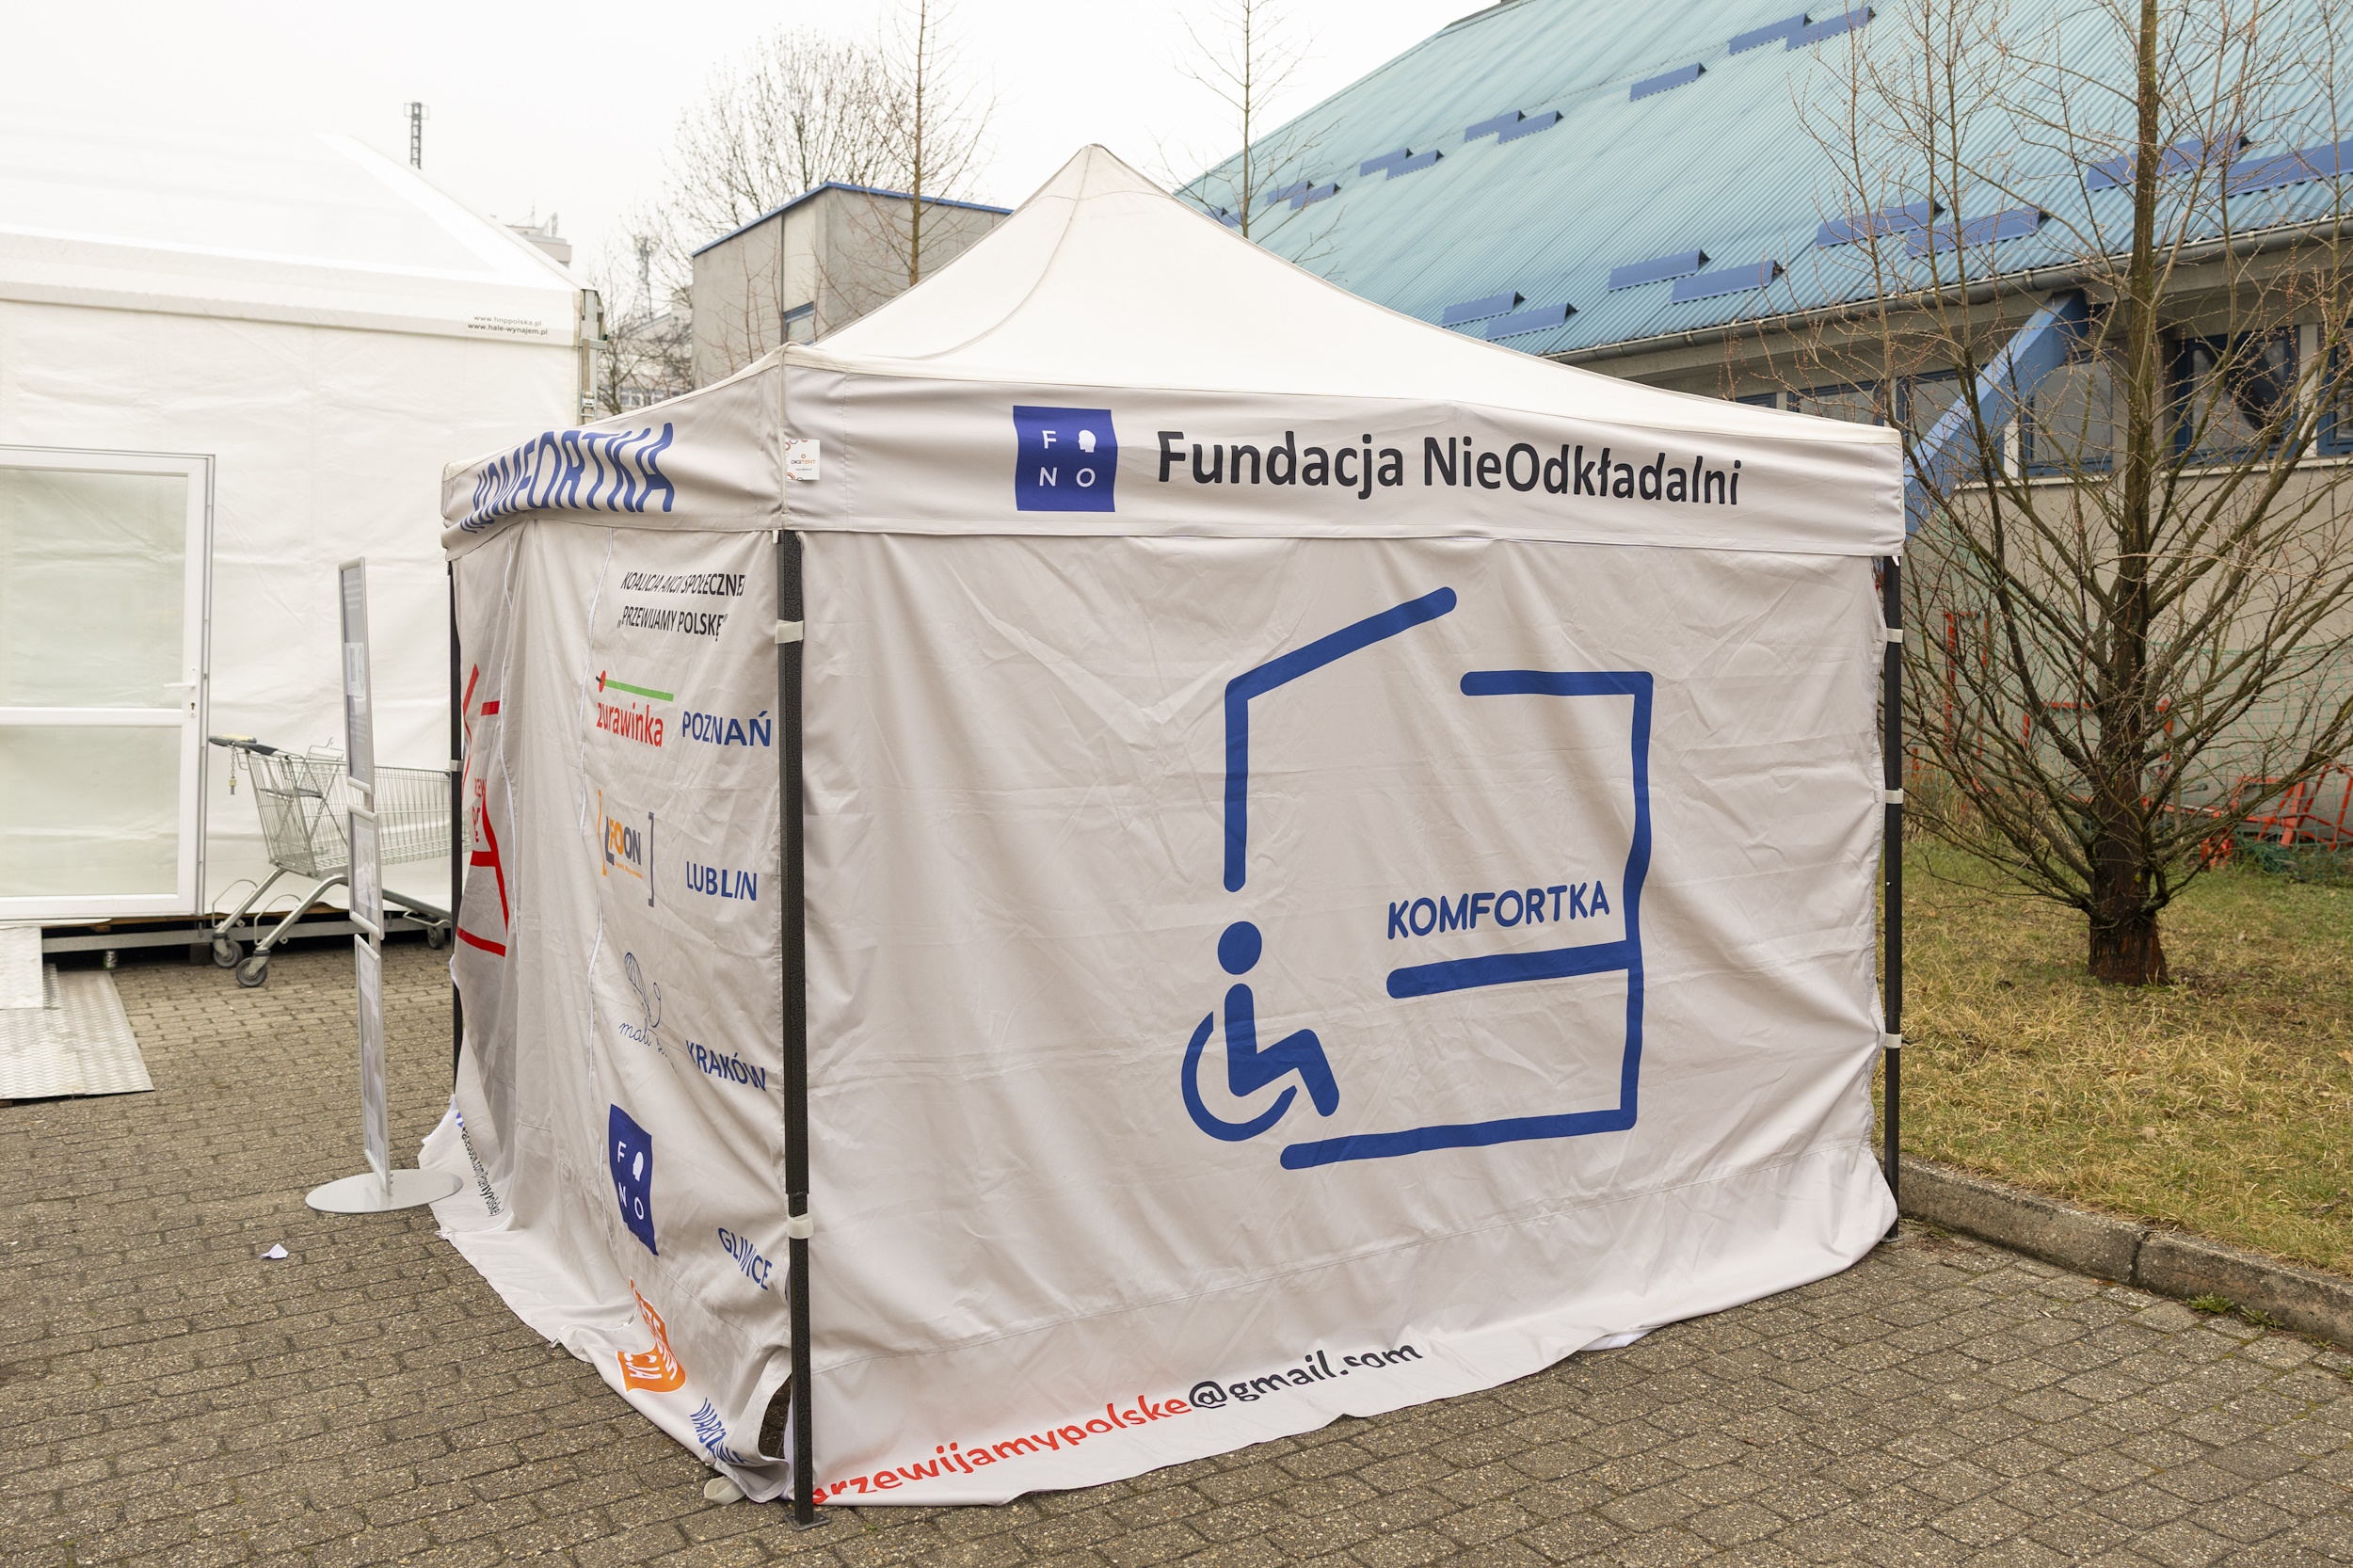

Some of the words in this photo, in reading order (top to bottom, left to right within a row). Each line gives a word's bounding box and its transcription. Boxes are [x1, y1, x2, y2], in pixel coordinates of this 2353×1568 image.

[468, 323, 548, 335] www.hale-wynajem.pl
[460, 423, 675, 534] KOMFORTKA
[1158, 431, 1403, 500] Fundacja
[1424, 436, 1741, 505] NieOdkładalni
[620, 571, 664, 592] KOALICJA
[682, 711, 771, 747] POZNAŃ
[686, 861, 758, 902] LUBLIN
[1387, 880, 1610, 940] KOMFORTKA
[685, 1040, 766, 1092] KRAKÓW
